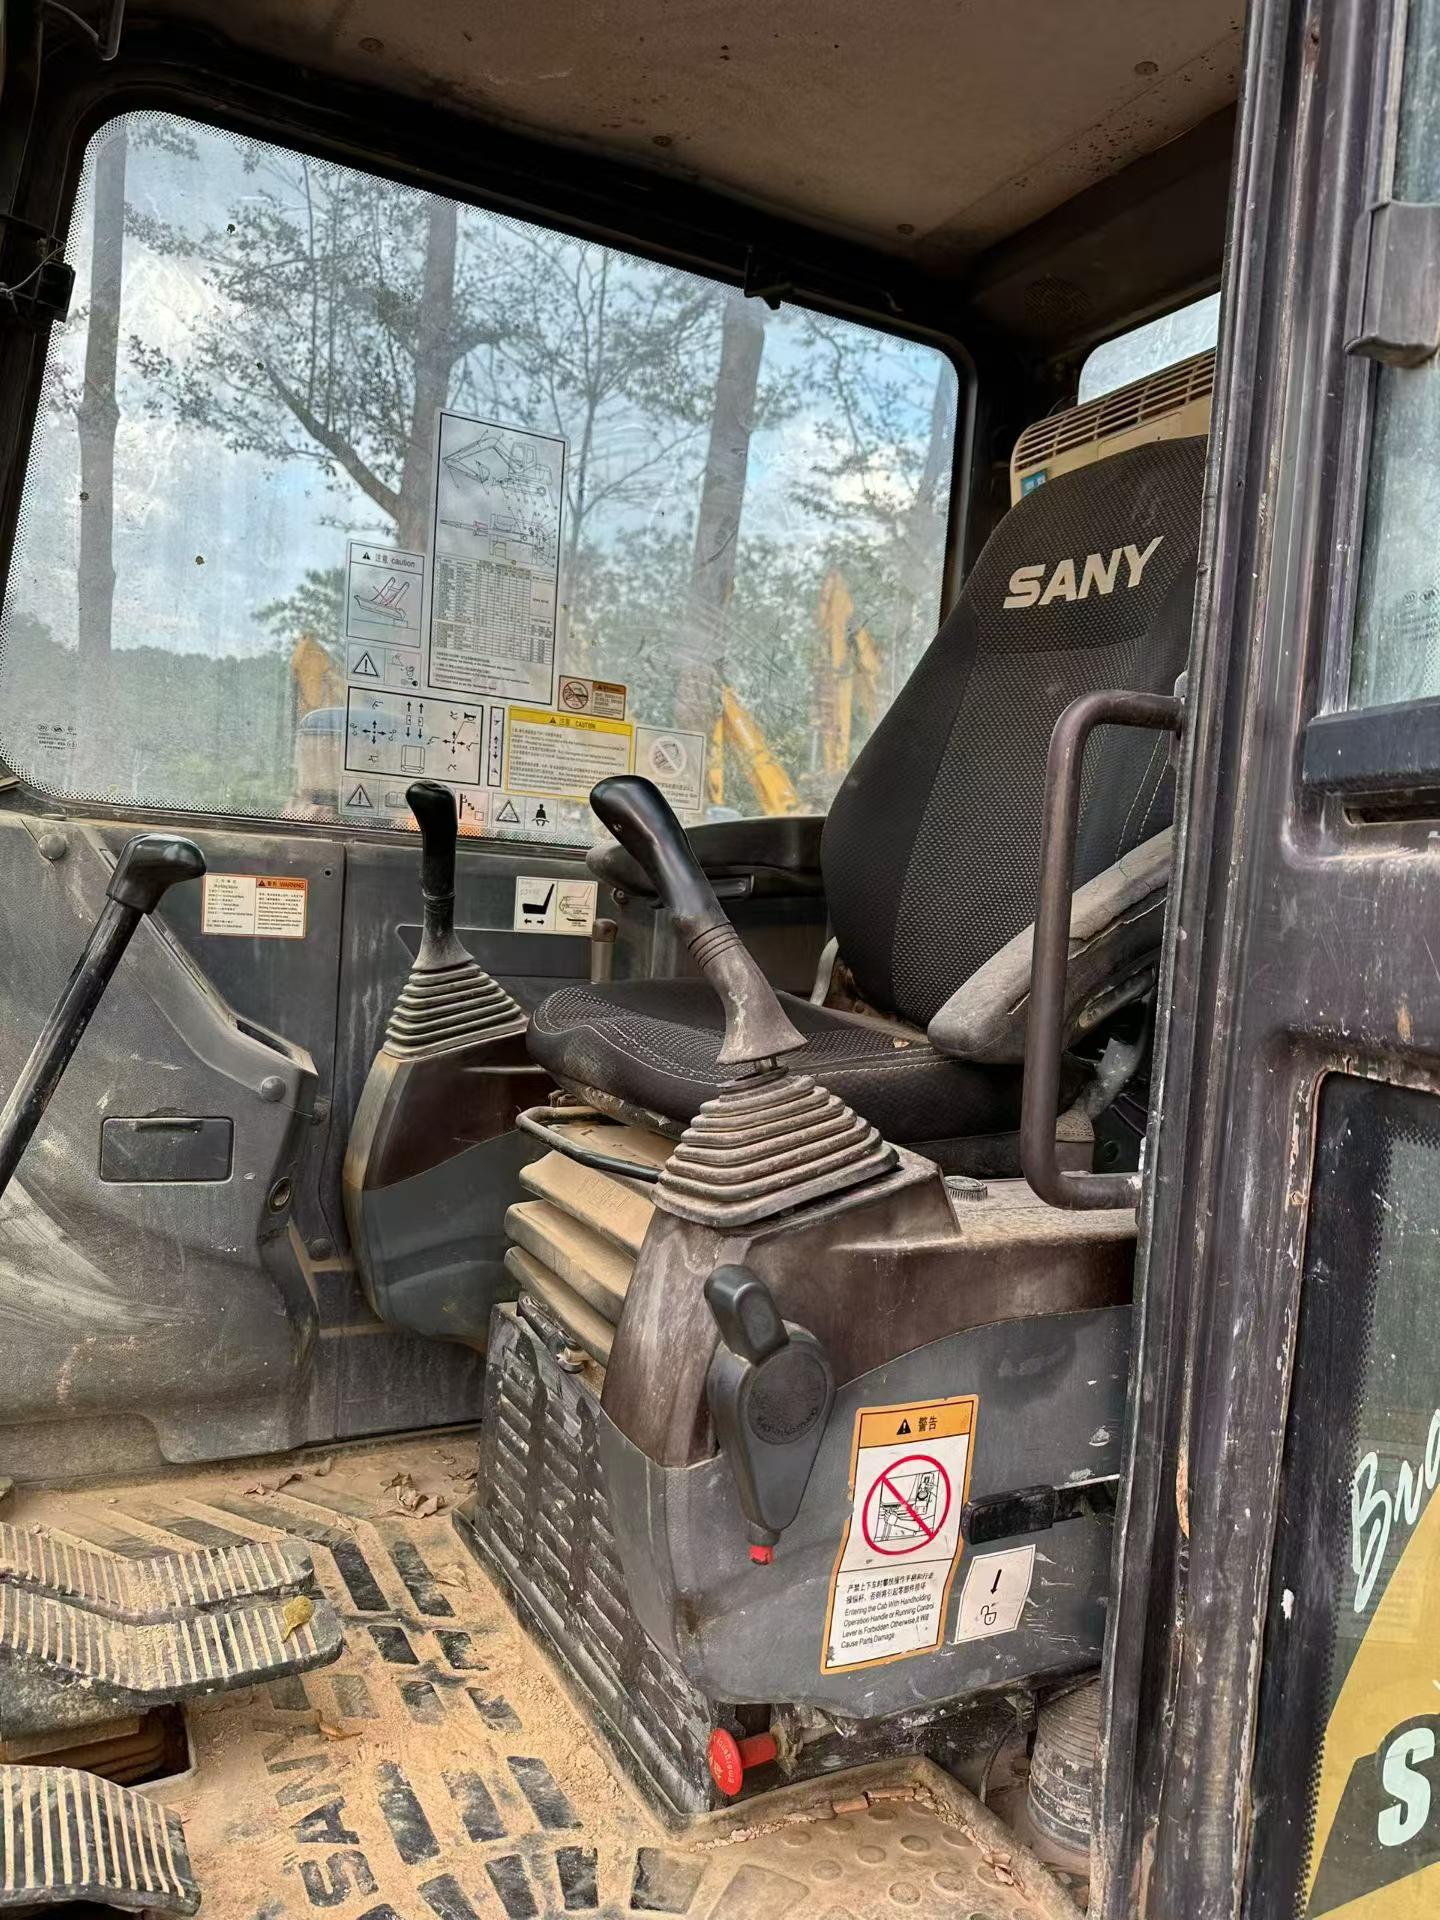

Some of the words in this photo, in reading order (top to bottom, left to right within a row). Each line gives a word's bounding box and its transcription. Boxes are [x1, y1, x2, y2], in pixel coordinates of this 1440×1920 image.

[1003, 535, 1165, 609] SANY
[279, 880, 304, 889] WARNING
[918, 1416, 938, 1432] 警告
[843, 1616, 869, 1628] Operation
[870, 1613, 888, 1622] Handle
[895, 1607, 916, 1618] Running
[916, 1603, 935, 1612] Control
[844, 1606, 867, 1616] Entering
[868, 1605, 876, 1613] the
[876, 1602, 887, 1610] Cab
[888, 1600, 900, 1608] With
[842, 1629, 857, 1638] Lever
[889, 1617, 915, 1628] Otherwise
[841, 1639, 859, 1649] Cause
[859, 1637, 873, 1646] Parts
